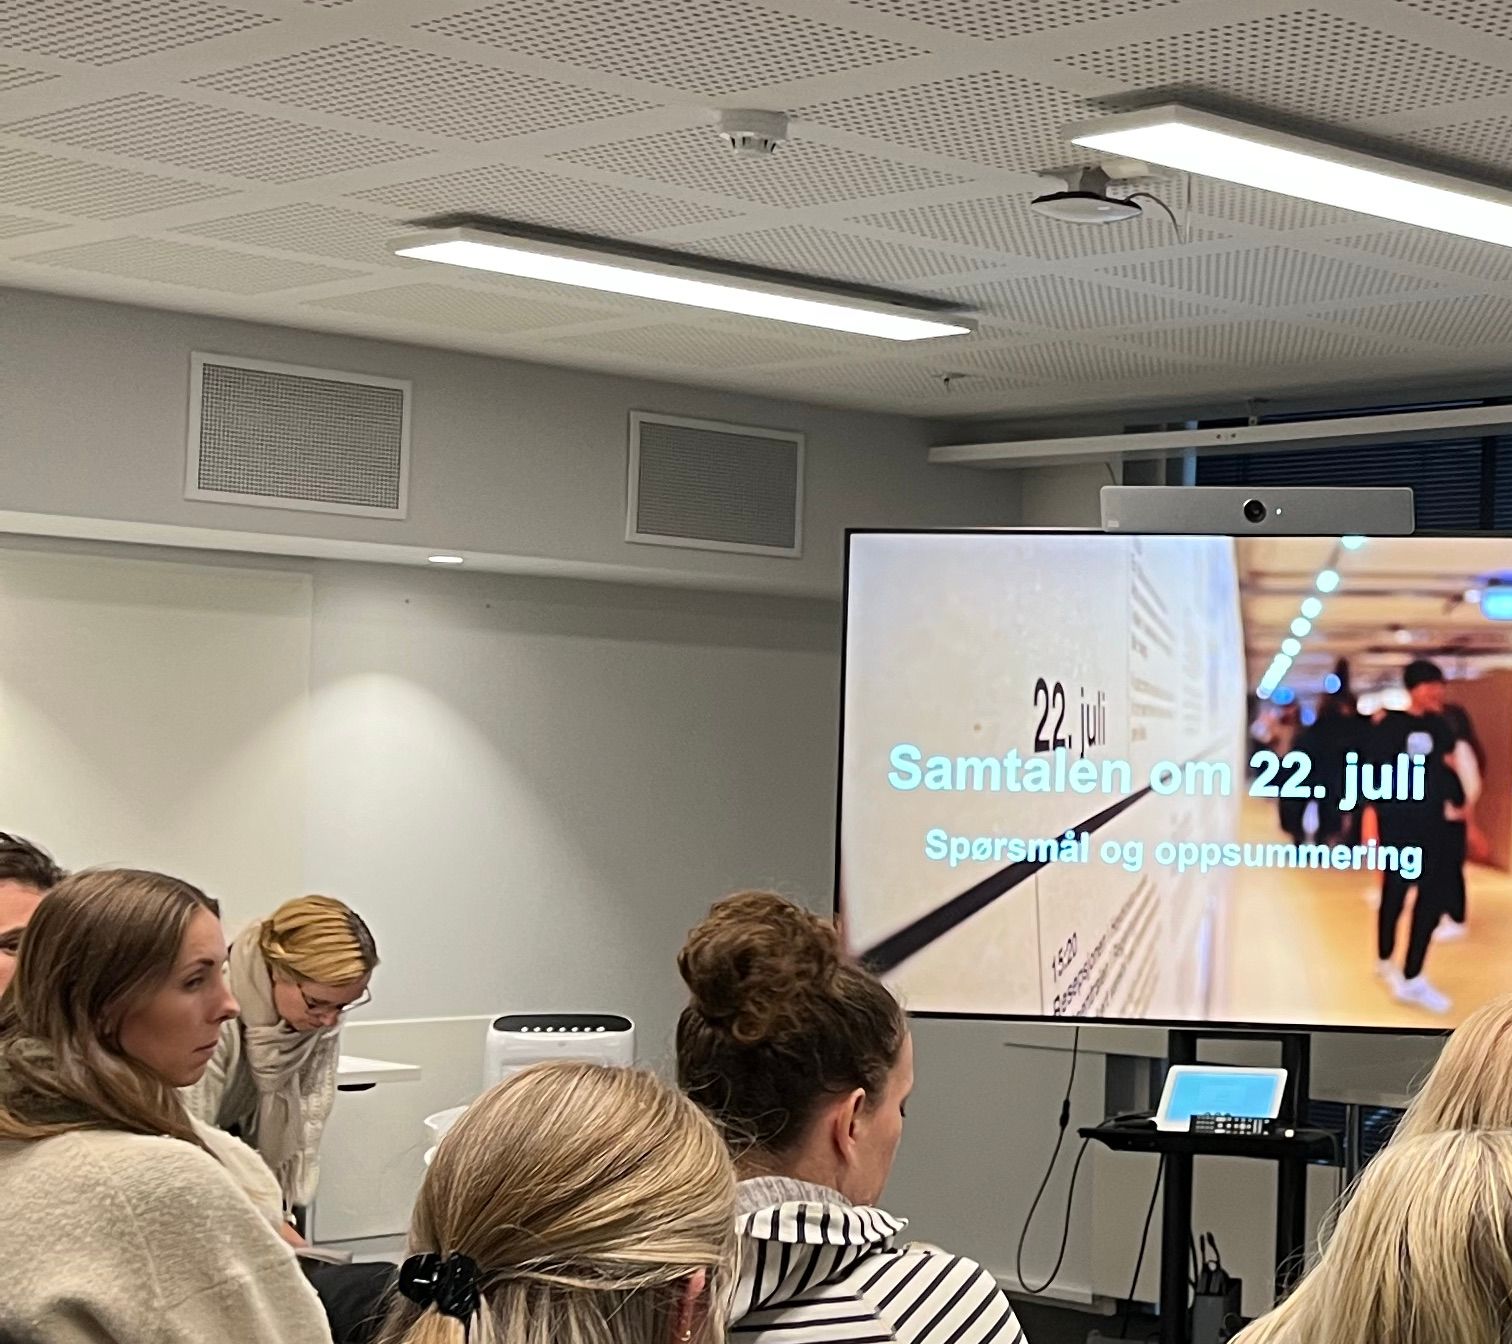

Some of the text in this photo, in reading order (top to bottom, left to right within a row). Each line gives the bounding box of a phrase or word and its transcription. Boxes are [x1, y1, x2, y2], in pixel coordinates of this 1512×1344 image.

[1033, 677, 1072, 753] 22.
[1080, 686, 1106, 759] juli
[888, 744, 1426, 811] Samtalen om 22. juli
[925, 828, 1423, 880] Spørsmål og oppsummering
